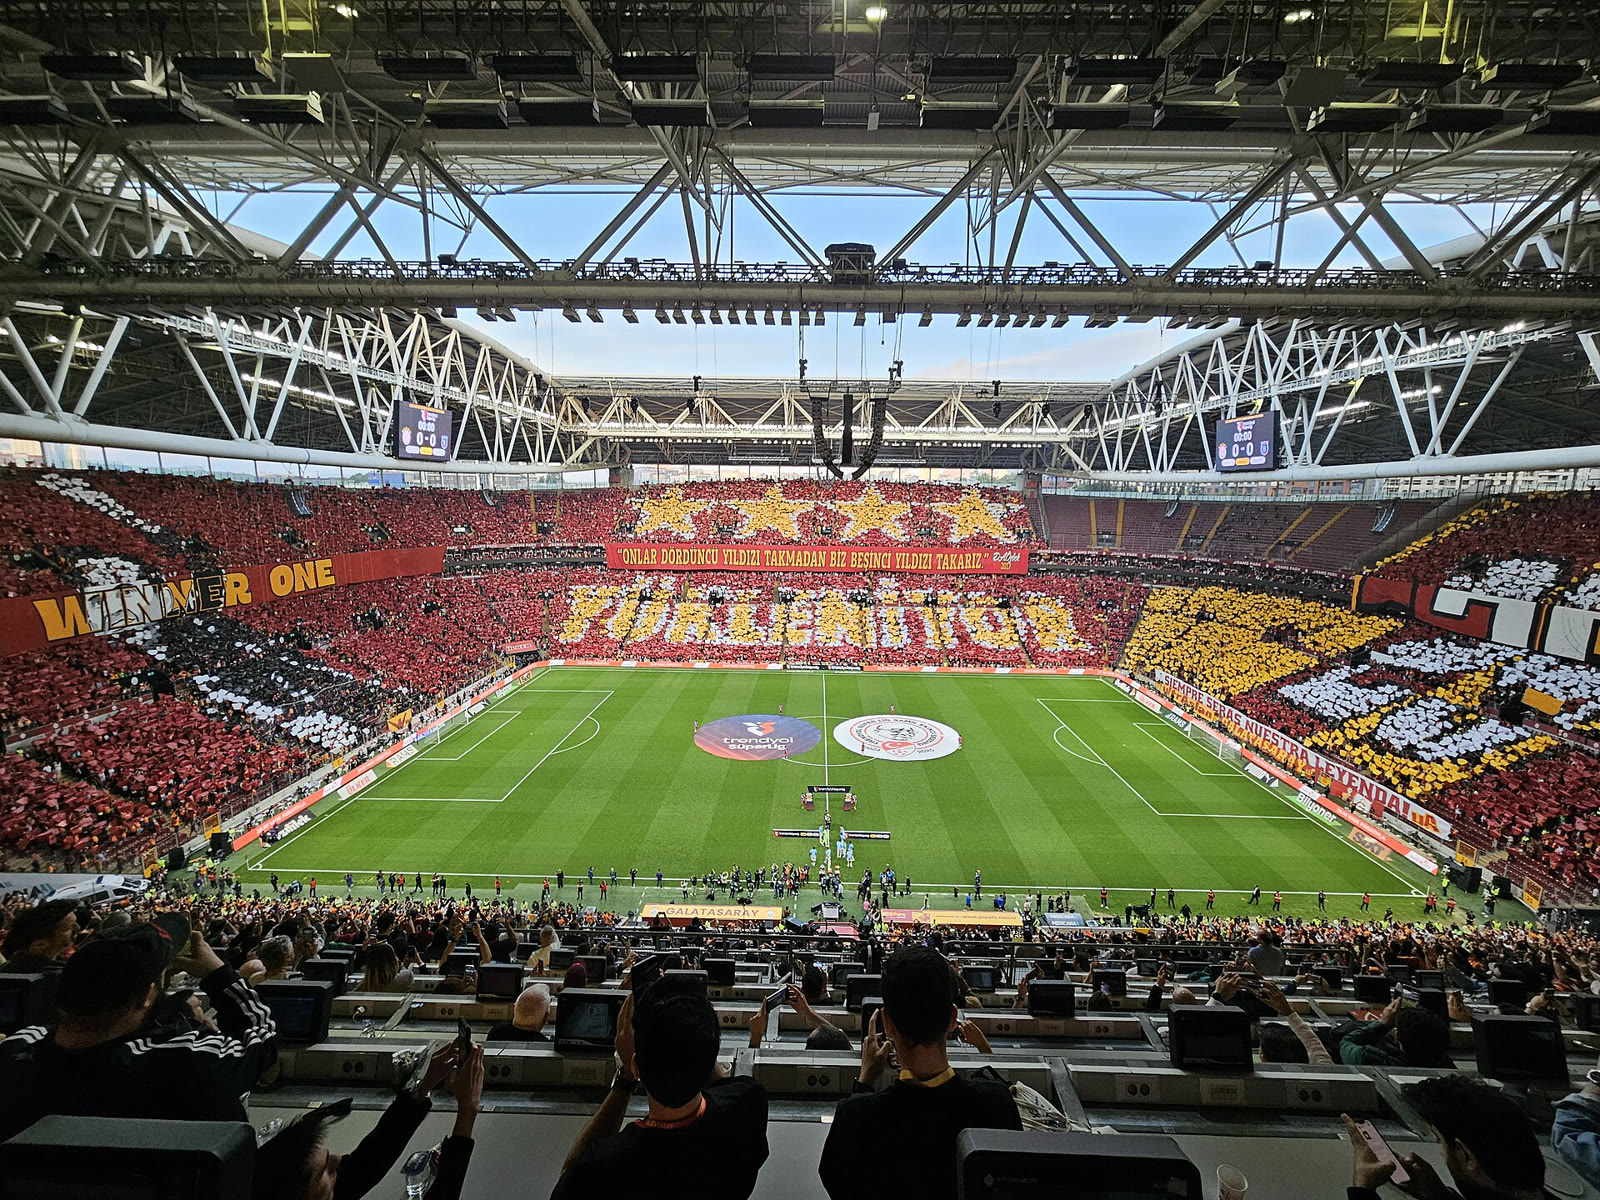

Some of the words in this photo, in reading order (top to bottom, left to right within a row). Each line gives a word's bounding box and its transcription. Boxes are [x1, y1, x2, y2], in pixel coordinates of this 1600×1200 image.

[661, 546, 718, 565] DÖRDÜNCÜ
[723, 549, 760, 566] YILDIZI
[764, 550, 825, 567] TAKMADAN
[829, 549, 847, 567] BİZ
[850, 549, 891, 571] BEŞİNCİ
[895, 552, 932, 569] YILDIZI
[33, 572, 252, 641] WINNER
[269, 558, 336, 597] ONE
[723, 737, 793, 745] trendyol
[1165, 675, 1204, 706] SIEMPRE
[1206, 694, 1241, 725] SERAS
[1244, 718, 1310, 768] NUESTRA
[1315, 754, 1411, 820] LEYENDA!
[346, 775, 371, 795] ÜLKER
[1296, 791, 1337, 823] Bilyoner
[666, 907, 759, 917] GALATASARAY
